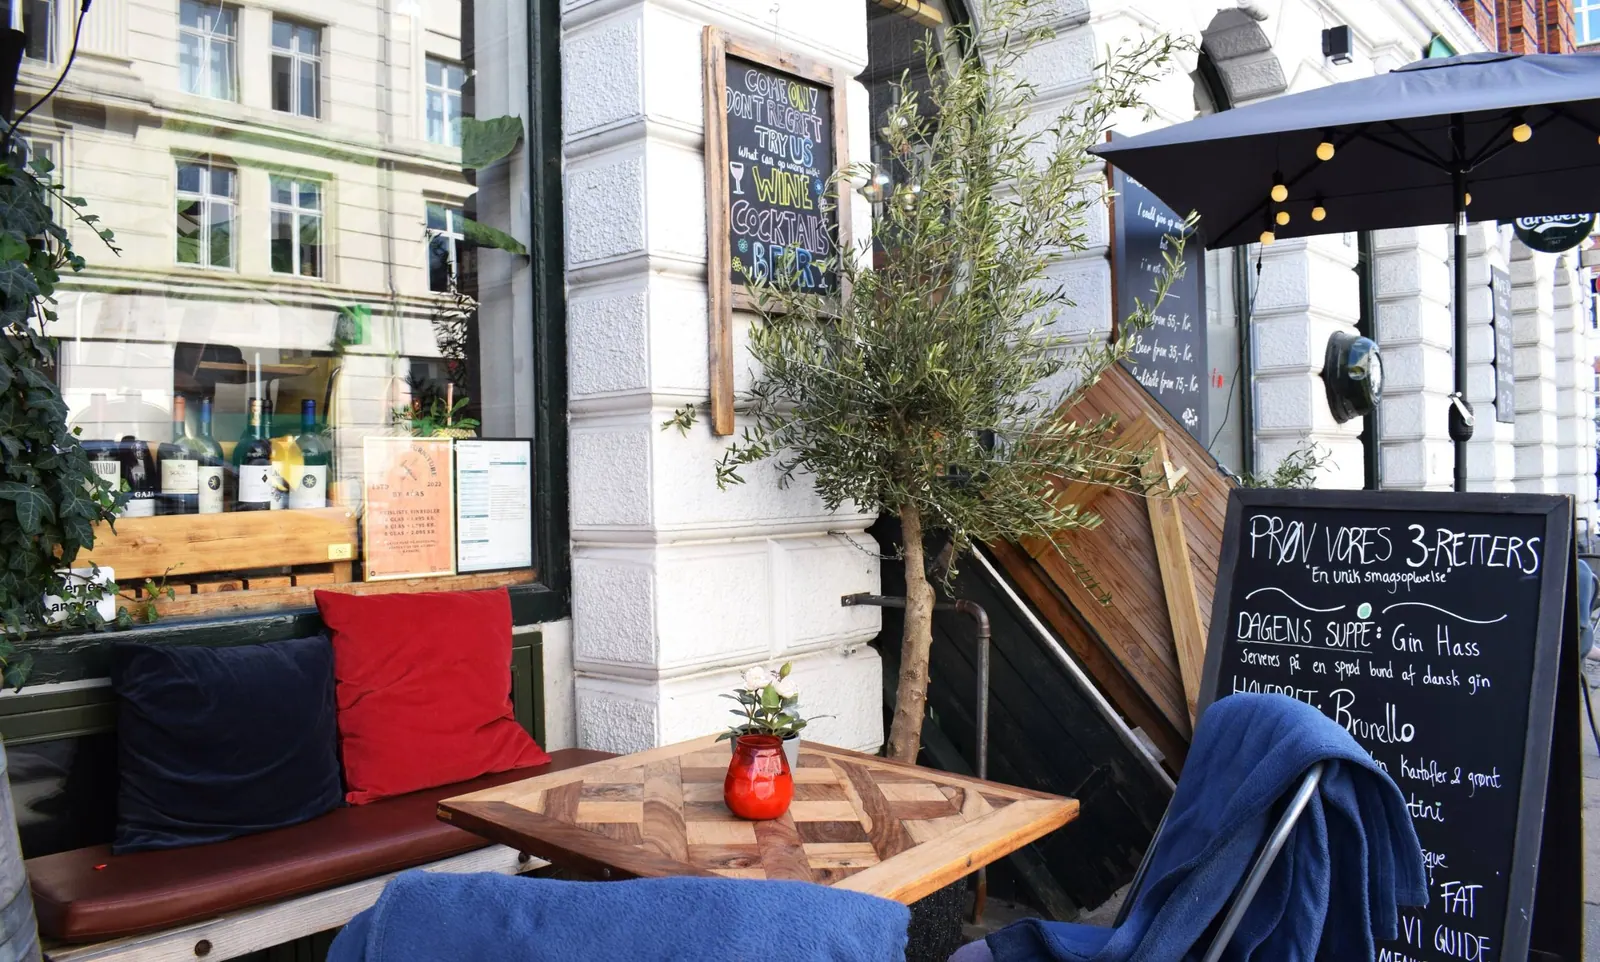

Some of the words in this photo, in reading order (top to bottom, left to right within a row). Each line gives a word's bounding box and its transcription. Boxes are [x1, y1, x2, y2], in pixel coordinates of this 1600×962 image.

[745, 69, 788, 104] COME
[767, 100, 822, 143] REGRET
[738, 146, 758, 160] What
[761, 154, 774, 166] can
[777, 160, 785, 172] go
[754, 125, 788, 157] TRY
[789, 135, 813, 167] US
[752, 166, 813, 209] WINE
[731, 200, 829, 255] COCKTAILS
[753, 241, 815, 288] BER
[1135, 335, 1152, 354] Beer
[1152, 339, 1167, 362] from
[1160, 371, 1173, 394] from
[1249, 514, 1317, 566] PRØV
[1326, 526, 1392, 564] VORES
[1406, 523, 1541, 575] 3-RETTERS
[1334, 569, 1361, 584] unik
[1237, 611, 1312, 643] DAGENS
[1326, 621, 1383, 648] SUPPE:
[1392, 623, 1424, 653] Gin
[1437, 624, 1480, 657] Hass
[1240, 648, 1280, 667] Serveres
[1289, 653, 1301, 675] på
[1313, 661, 1327, 675] en
[1369, 660, 1393, 678] bund
[1401, 664, 1416, 686] af
[1423, 664, 1460, 686] dansk
[1468, 673, 1491, 695] gin
[1329, 688, 1415, 743] Brunello
[1450, 767, 1461, 784] &
[1468, 767, 1502, 797] grønt
[1402, 792, 1444, 822] tini
[1420, 849, 1449, 878] sque
[1440, 881, 1484, 918] FAT
[1402, 915, 1421, 949] VI
[1434, 924, 1491, 962] GUIDE
